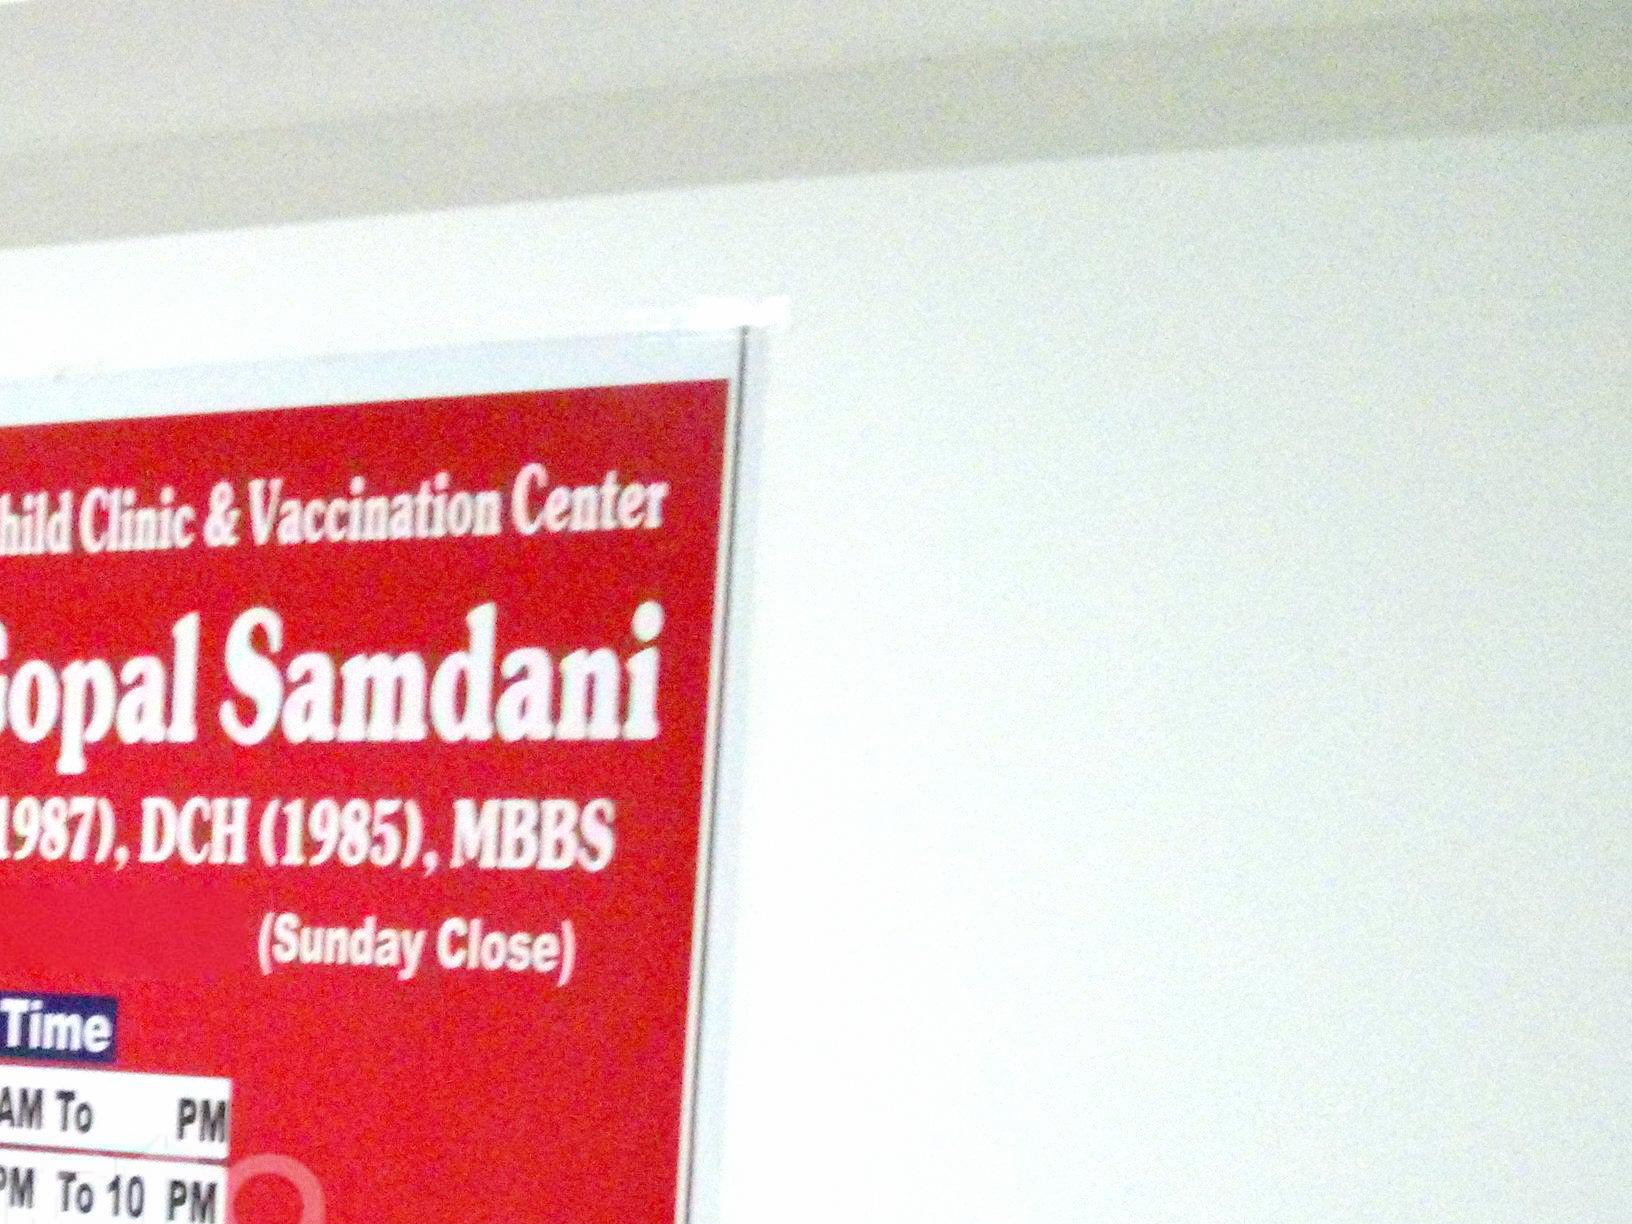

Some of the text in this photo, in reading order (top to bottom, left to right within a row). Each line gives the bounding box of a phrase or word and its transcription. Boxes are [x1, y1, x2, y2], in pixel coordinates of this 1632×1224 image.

[79, 484, 194, 552] Clinic
[204, 480, 242, 547] &
[247, 472, 502, 545] Vaccination
[511, 462, 670, 534] Center
[219, 601, 665, 746] Samdani
[139, 795, 246, 865] DCH
[260, 797, 441, 879] (1985),
[453, 799, 617, 874] MBBS
[257, 911, 576, 986] (Sunday Close)
[0, 999, 116, 1053] Time
[56, 1089, 94, 1134] To
[177, 1097, 228, 1142] PM
[57, 1170, 94, 1213] To
[107, 1175, 145, 1218] 10
[168, 1180, 217, 1224] PM
